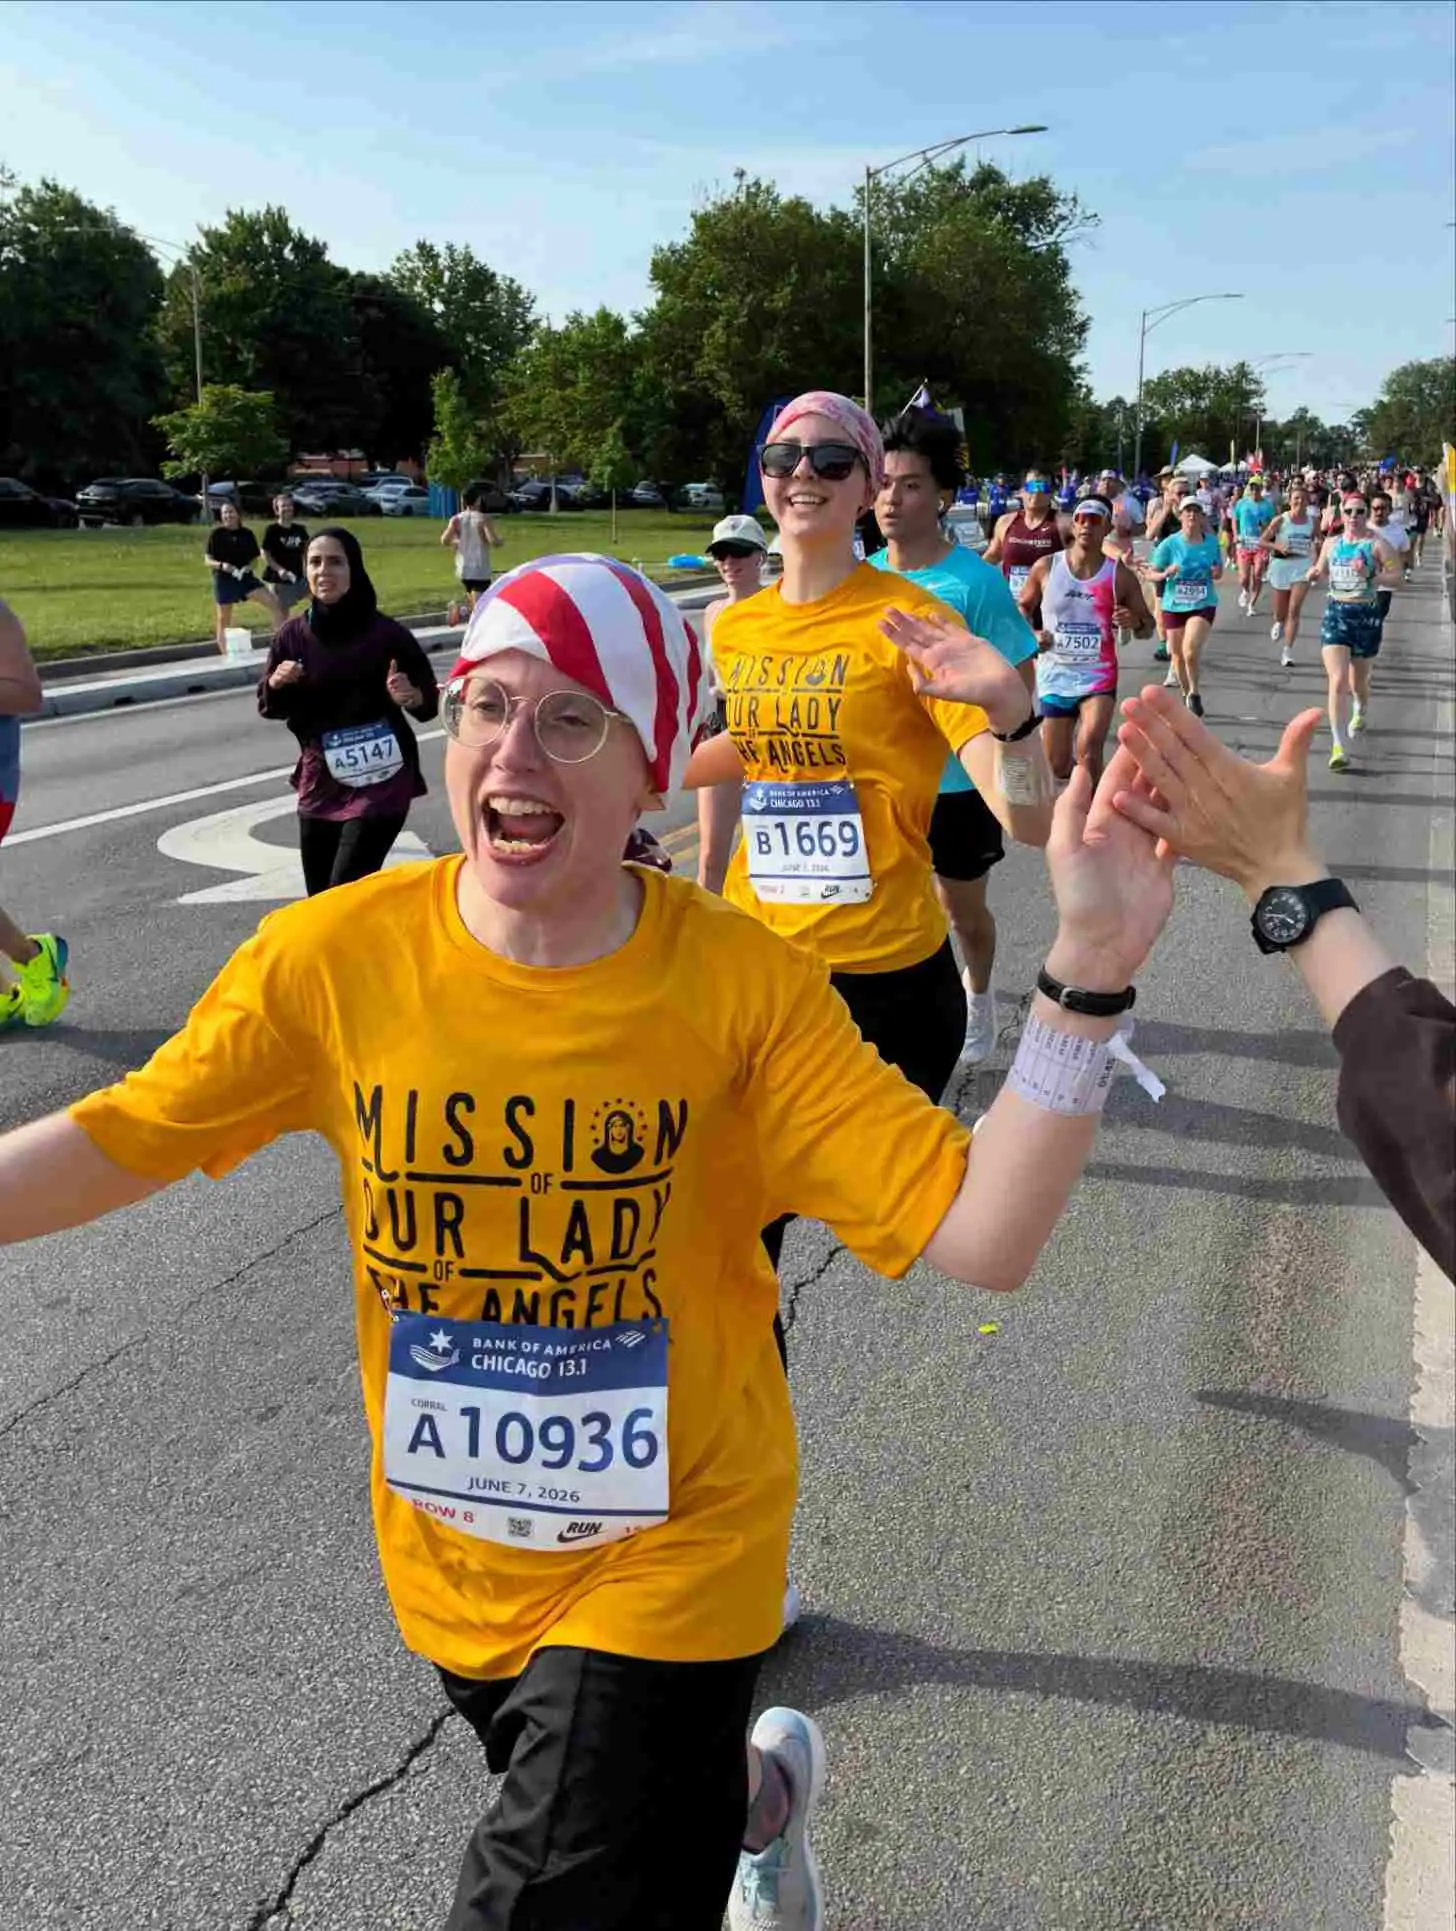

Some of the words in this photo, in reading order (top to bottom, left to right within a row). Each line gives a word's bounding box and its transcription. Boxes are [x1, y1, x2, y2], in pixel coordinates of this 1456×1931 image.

[776, 697, 842, 737] LADY
[346, 739, 392, 767] 5147
[768, 740, 847, 774] ANGELS
[756, 831, 772, 855] B
[774, 820, 859, 857] 1669
[530, 1172, 554, 1195] OF
[520, 1182, 671, 1280] LADY
[433, 1259, 455, 1282] OF
[481, 1268, 662, 1328] ANGELS
[472, 1337, 518, 1351] BANK
[521, 1341, 540, 1354] OF
[544, 1339, 612, 1356] AMERICA
[471, 1354, 552, 1379] CHICAGO
[558, 1358, 588, 1376] 13.1
[407, 1412, 446, 1459] A
[459, 1406, 658, 1473] 10936
[467, 1476, 512, 1494] JUNE
[517, 1483, 533, 1499] 7,
[538, 1486, 581, 1503] 2026
[412, 1498, 456, 1519] ROW
[463, 1511, 475, 1524] 8
[566, 1522, 602, 1535] RUN
